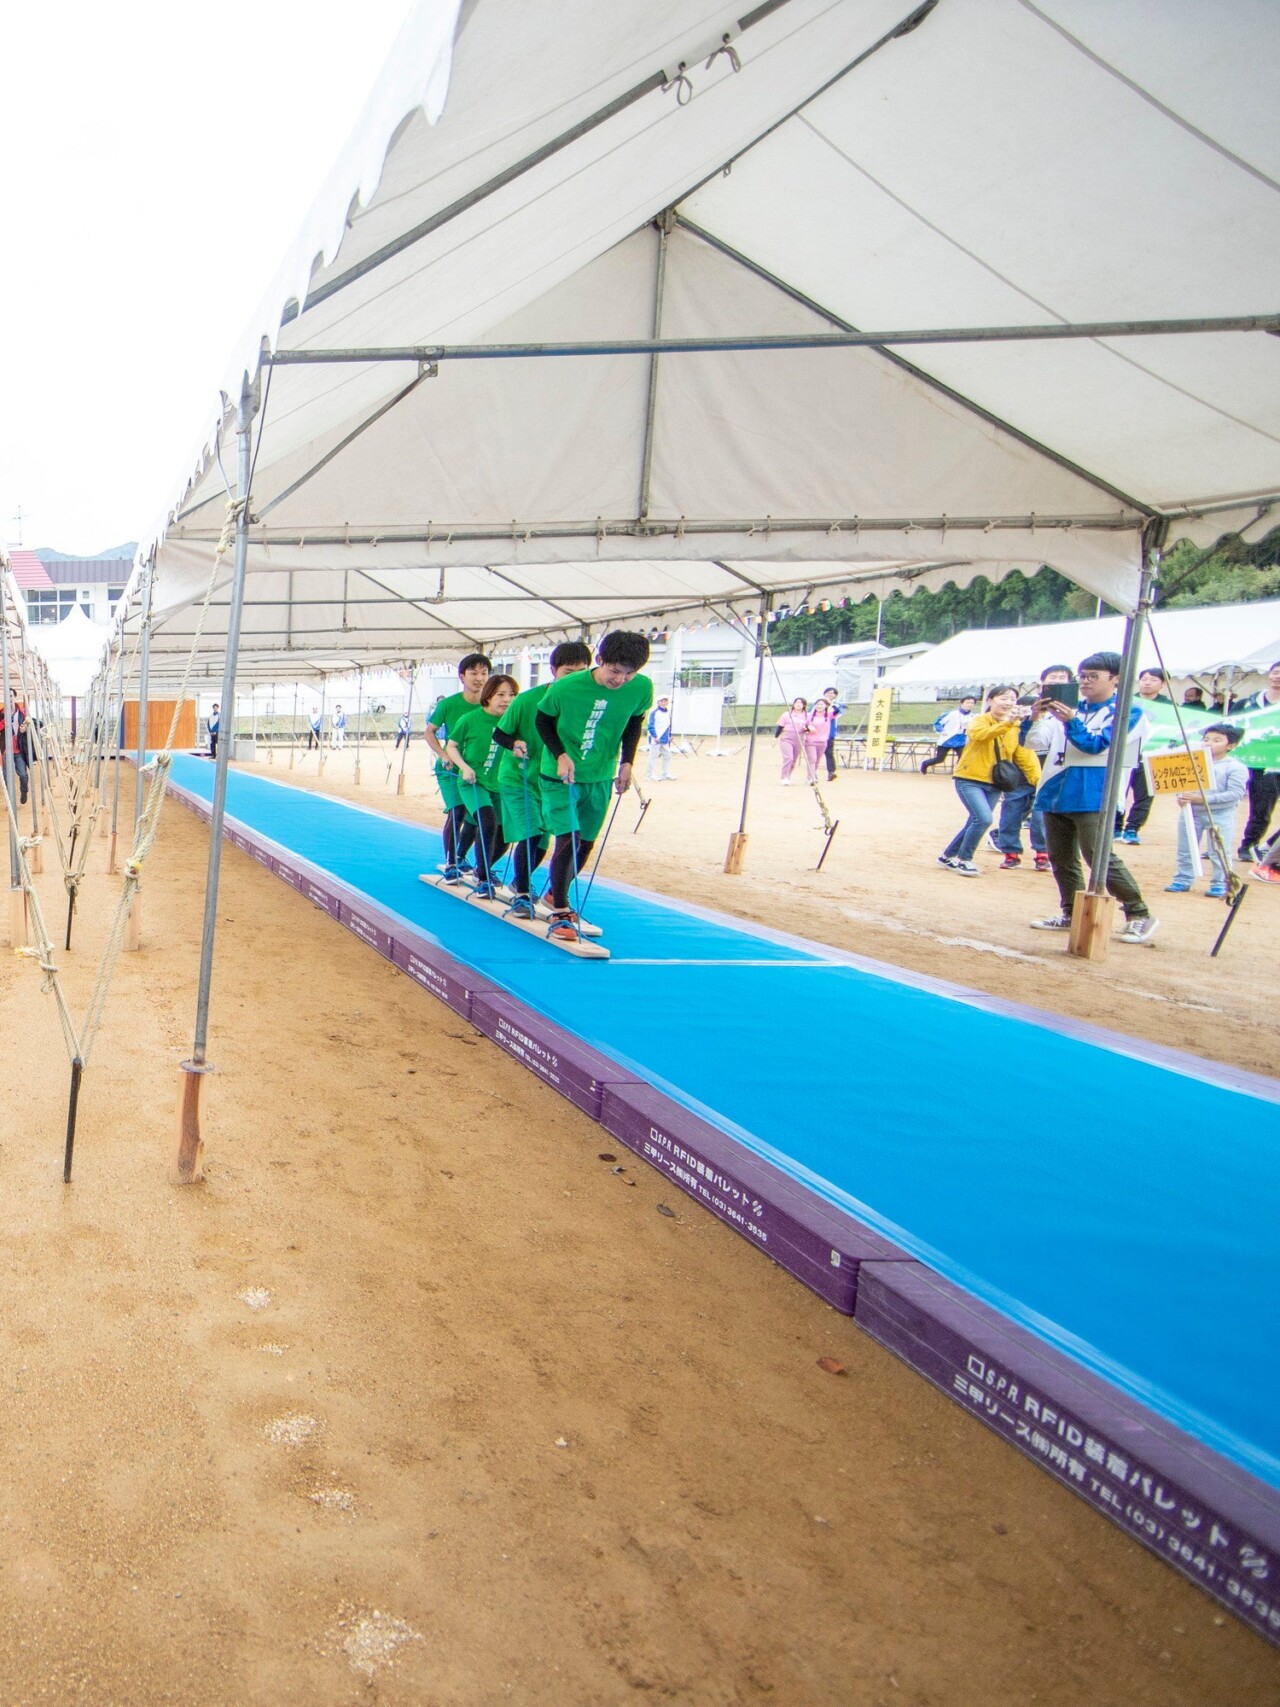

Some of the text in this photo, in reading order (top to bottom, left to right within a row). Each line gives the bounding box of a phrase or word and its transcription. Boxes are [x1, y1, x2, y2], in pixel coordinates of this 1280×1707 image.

[871, 699, 885, 746] 大会本部
[985, 1366, 1019, 1405] S.P.R.
[1091, 1477, 1123, 1510] TEL
